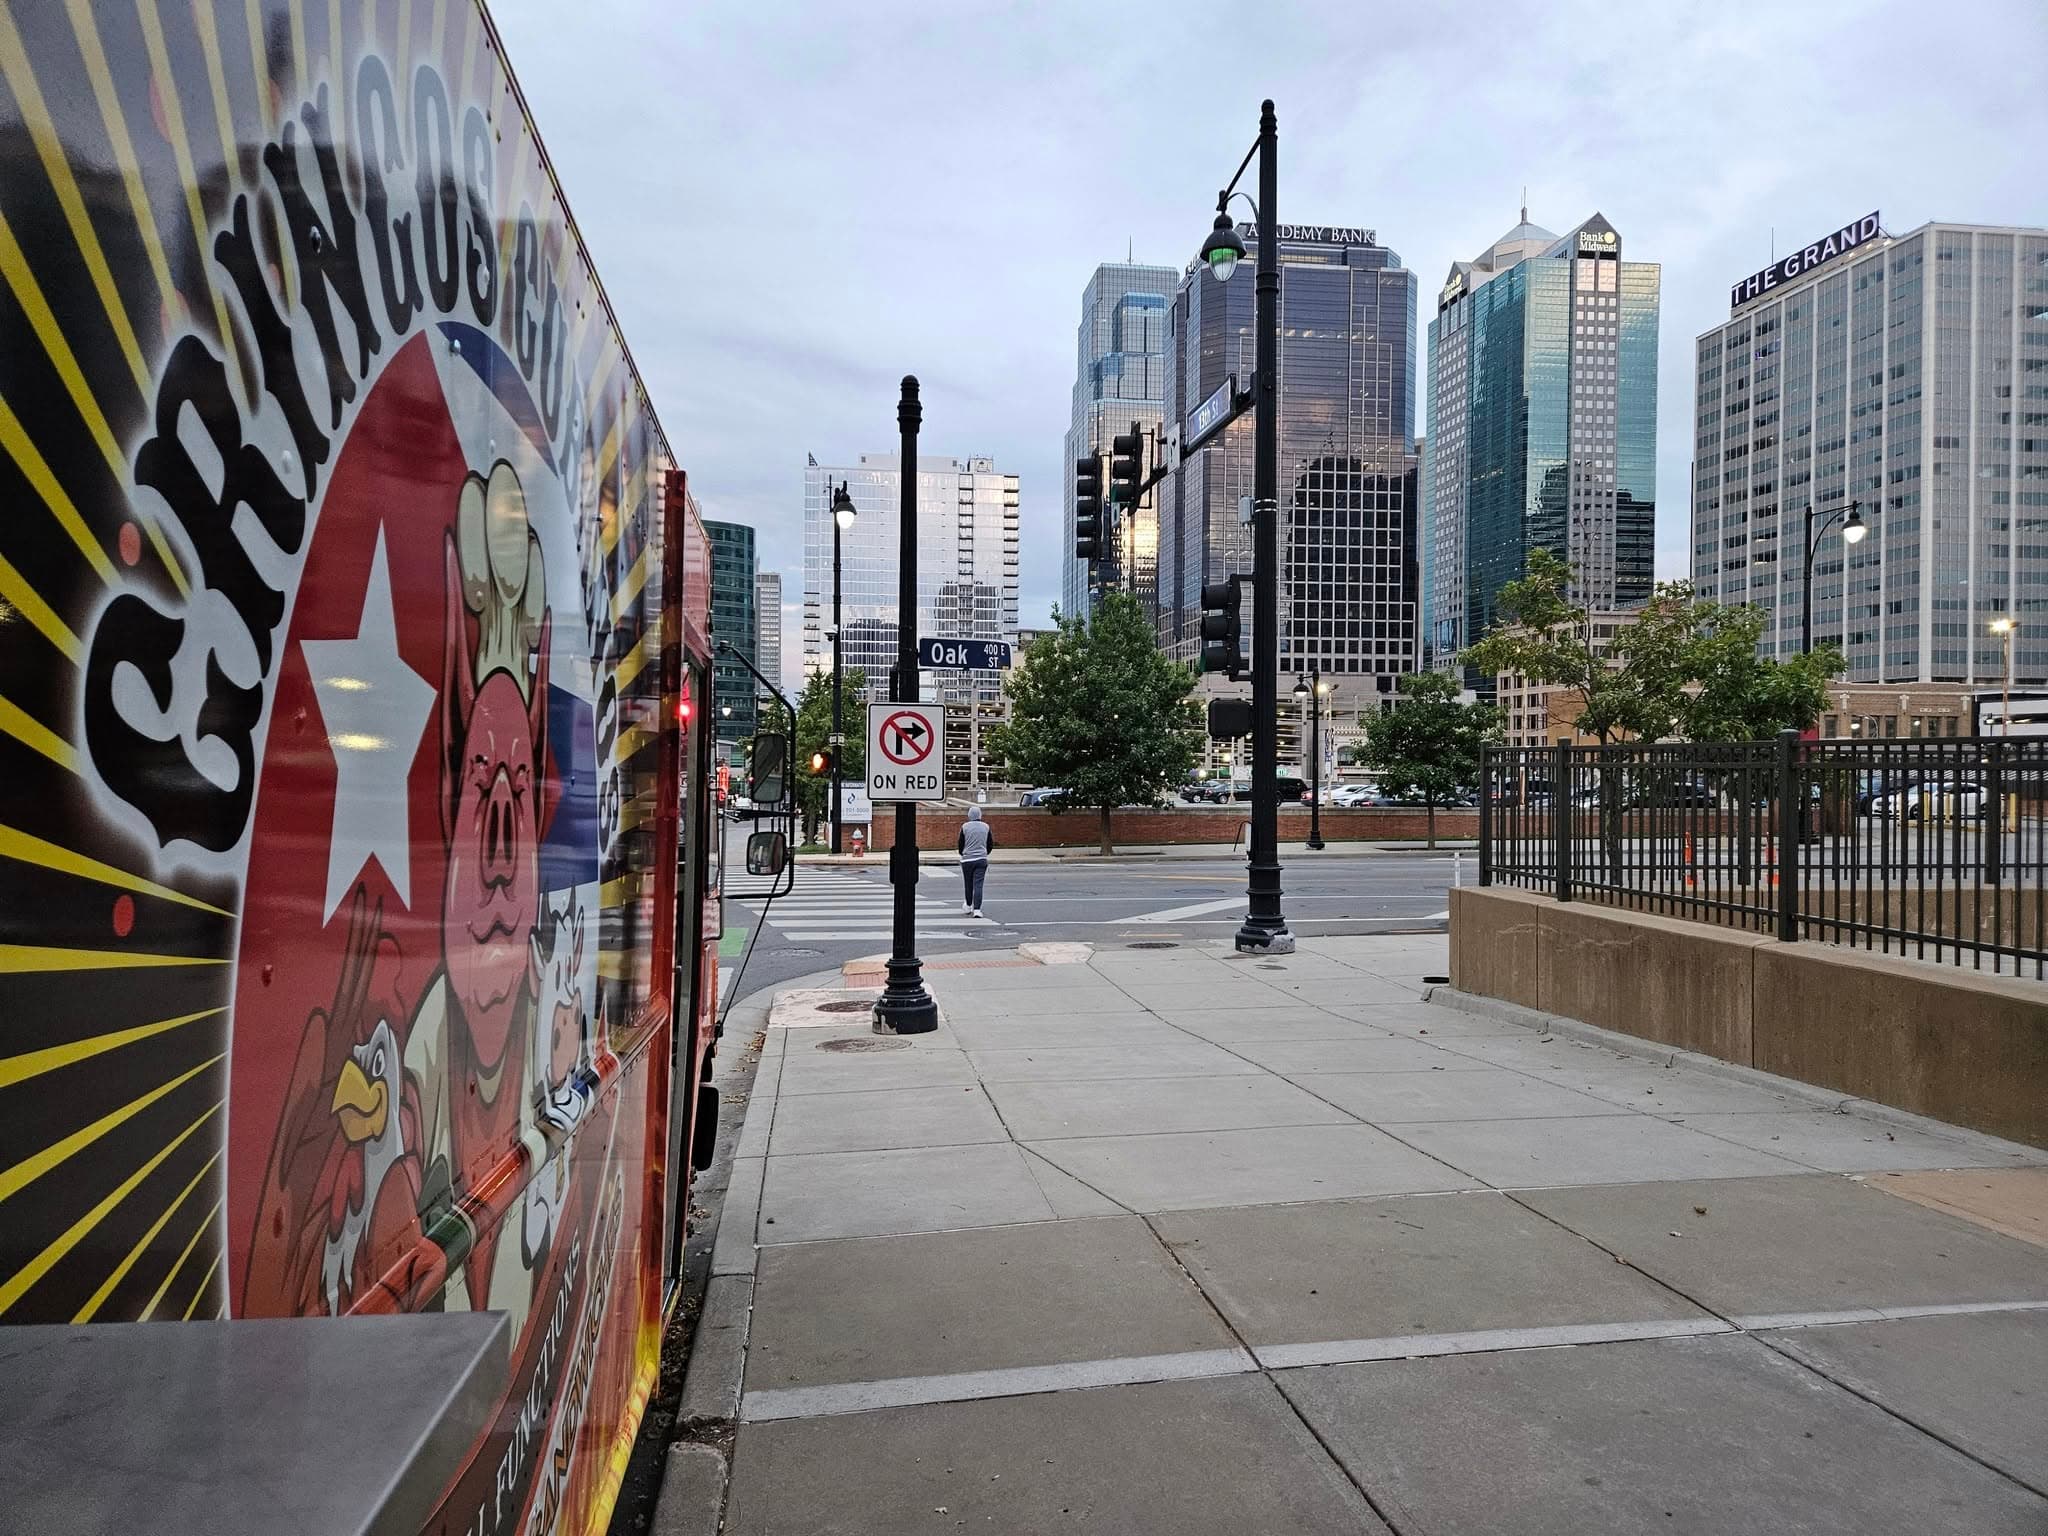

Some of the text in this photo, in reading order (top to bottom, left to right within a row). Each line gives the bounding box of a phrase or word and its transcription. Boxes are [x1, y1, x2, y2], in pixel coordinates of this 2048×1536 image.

[1247, 223, 1376, 243] ADEMY BANK
[1580, 231, 1605, 242] Bank
[1579, 240, 1617, 252] Midwest
[1732, 214, 1878, 304] THE GRAND
[84, 54, 498, 853] GRINGOS
[931, 642, 968, 665] Oak
[984, 643, 1005, 656] 400 E
[988, 656, 999, 668] ST
[873, 774, 896, 789] ON
[905, 775, 938, 790] RED
[495, 1226, 582, 1531] FUNCTIONS
